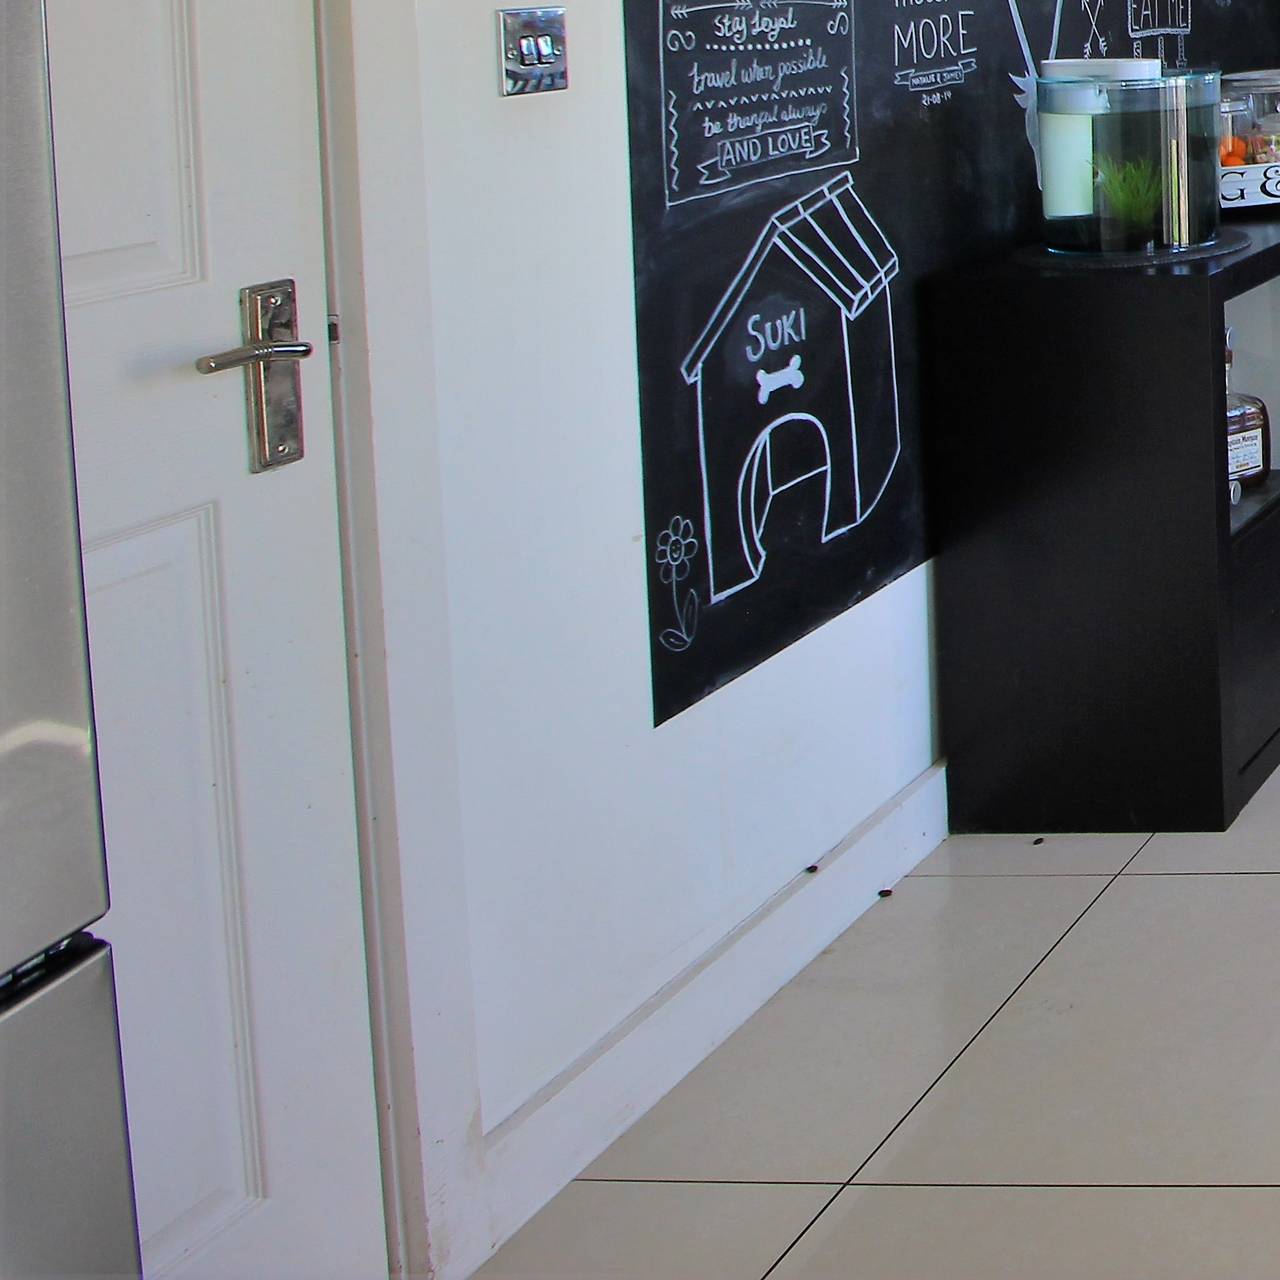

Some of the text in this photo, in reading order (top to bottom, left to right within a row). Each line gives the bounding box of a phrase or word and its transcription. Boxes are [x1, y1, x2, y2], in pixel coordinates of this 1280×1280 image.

[894, 10, 978, 66] MORE
[688, 47, 829, 95] travel when possible
[721, 129, 812, 168] AND LOVE
[745, 307, 807, 363] SUKI
